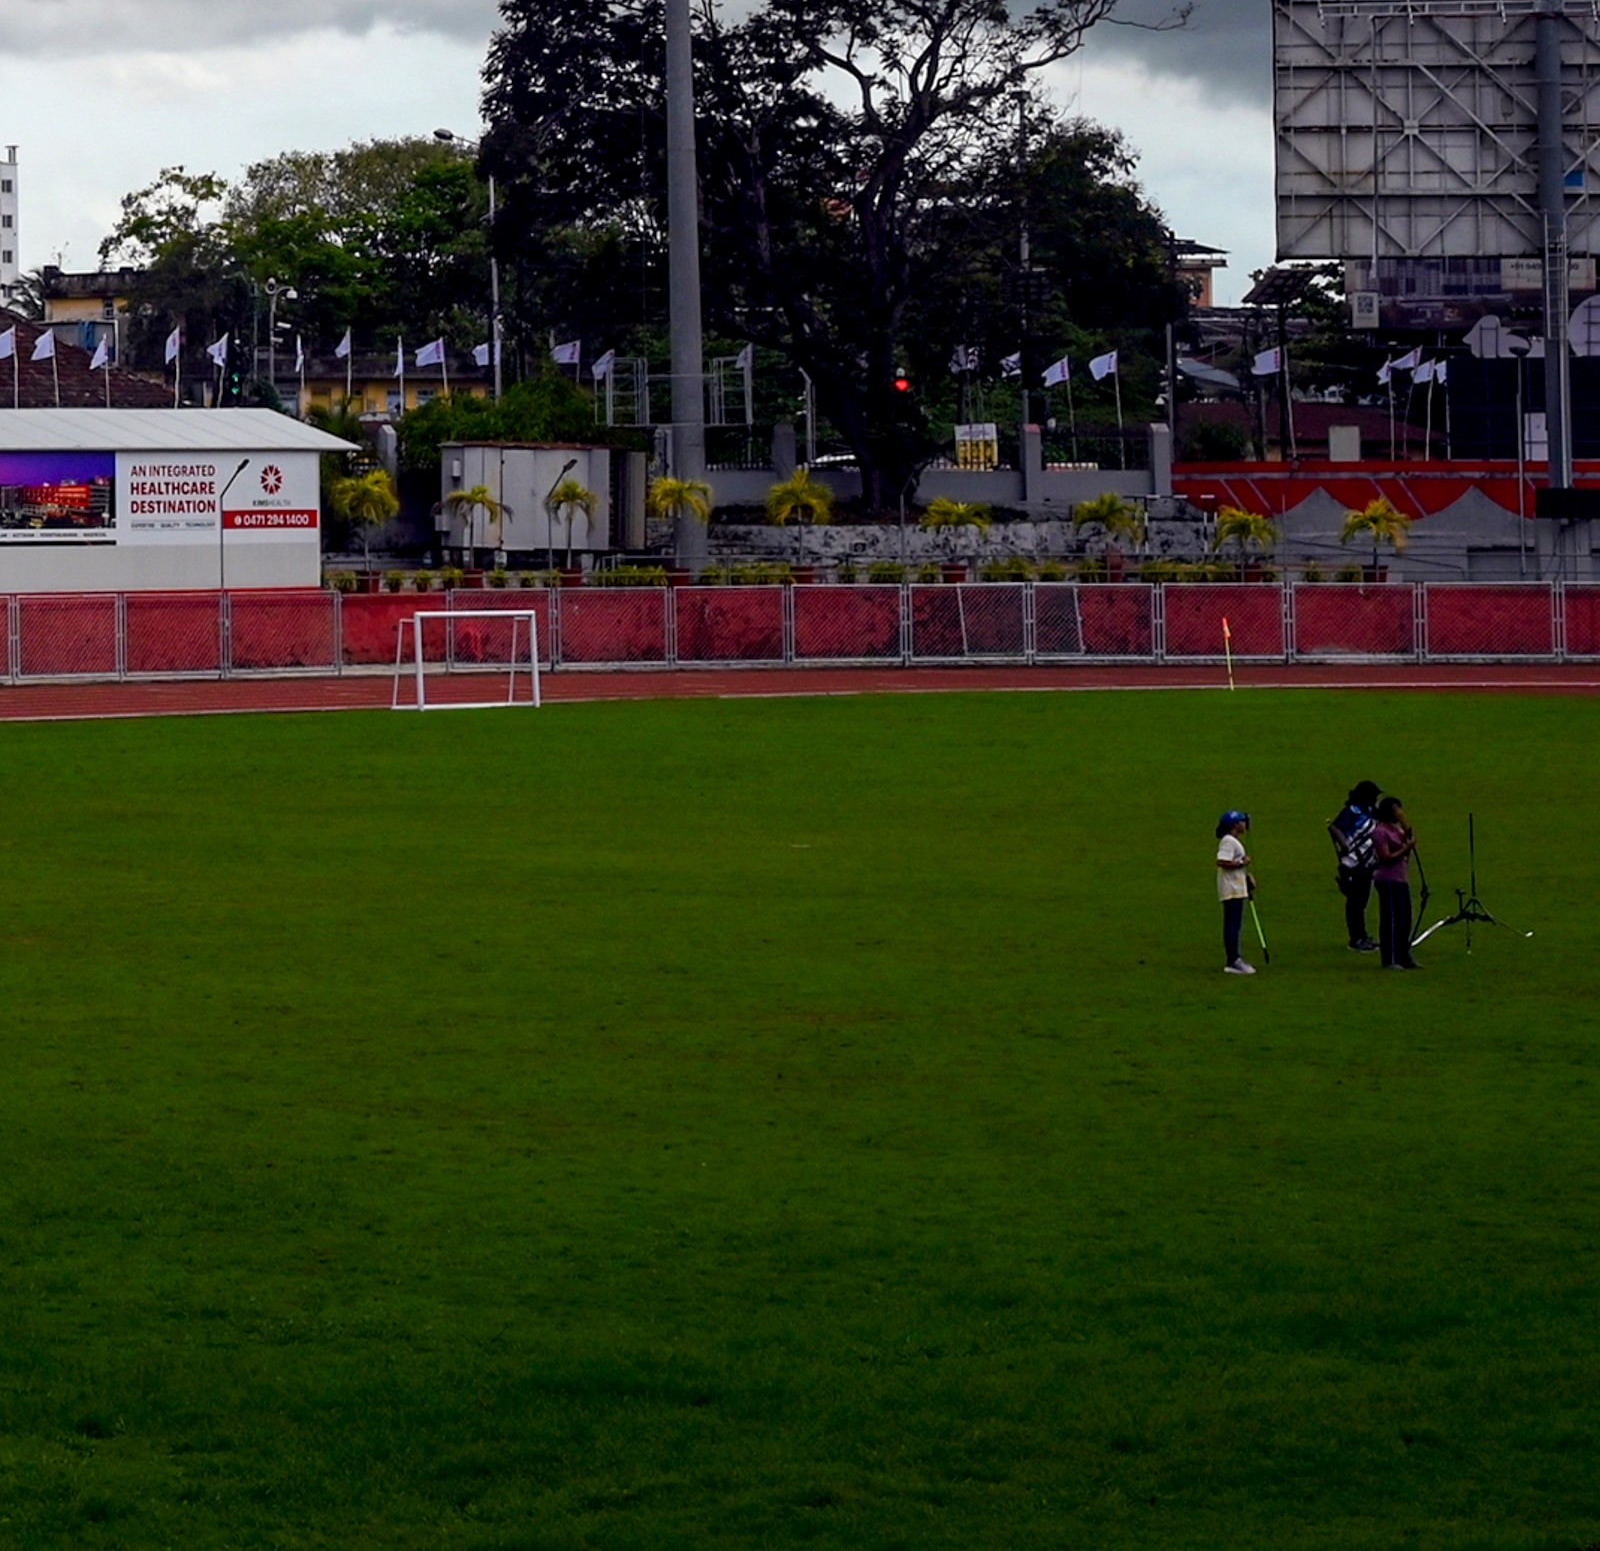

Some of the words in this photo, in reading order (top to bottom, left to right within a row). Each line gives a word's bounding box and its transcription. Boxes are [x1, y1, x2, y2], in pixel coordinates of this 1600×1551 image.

[130, 465, 147, 477] AN
[149, 464, 216, 477] INTEGRATED
[130, 481, 216, 496] HEALTHCARE
[130, 500, 216, 514] DESTINATION
[243, 514, 266, 526] 0471
[266, 514, 285, 526] 294
[286, 513, 309, 526] 1400
